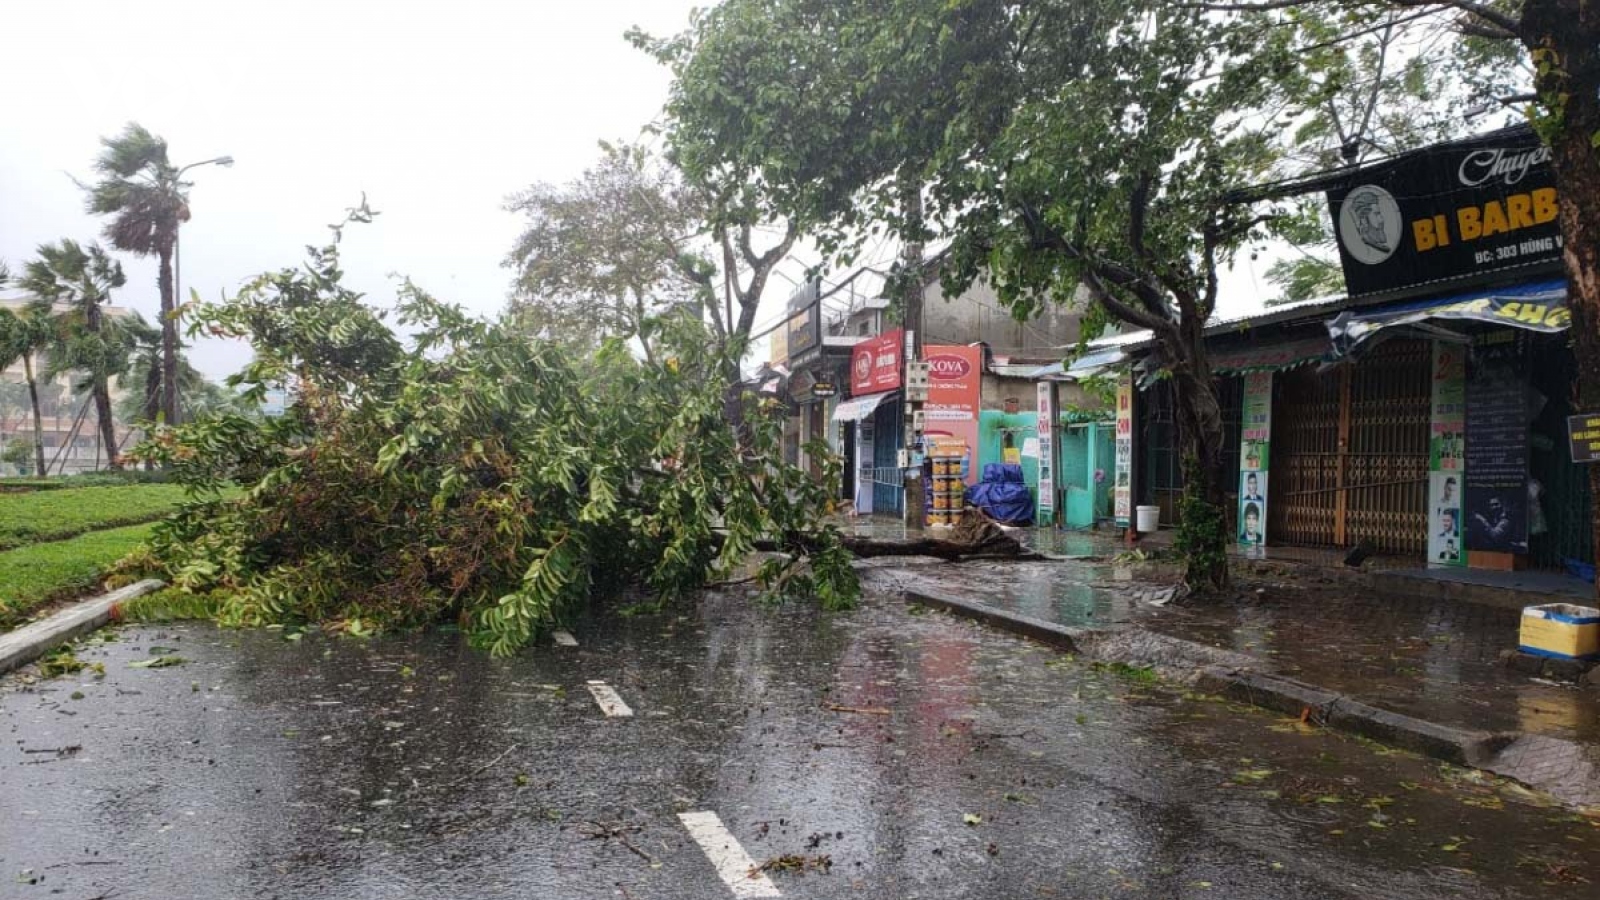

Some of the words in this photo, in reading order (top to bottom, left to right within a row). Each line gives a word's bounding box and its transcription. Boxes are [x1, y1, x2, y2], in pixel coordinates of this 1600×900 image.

[1412, 214, 1450, 251] BI
[1457, 187, 1559, 241] BARB
[1496, 244, 1517, 260] 303
[928, 360, 963, 372] KOVA
